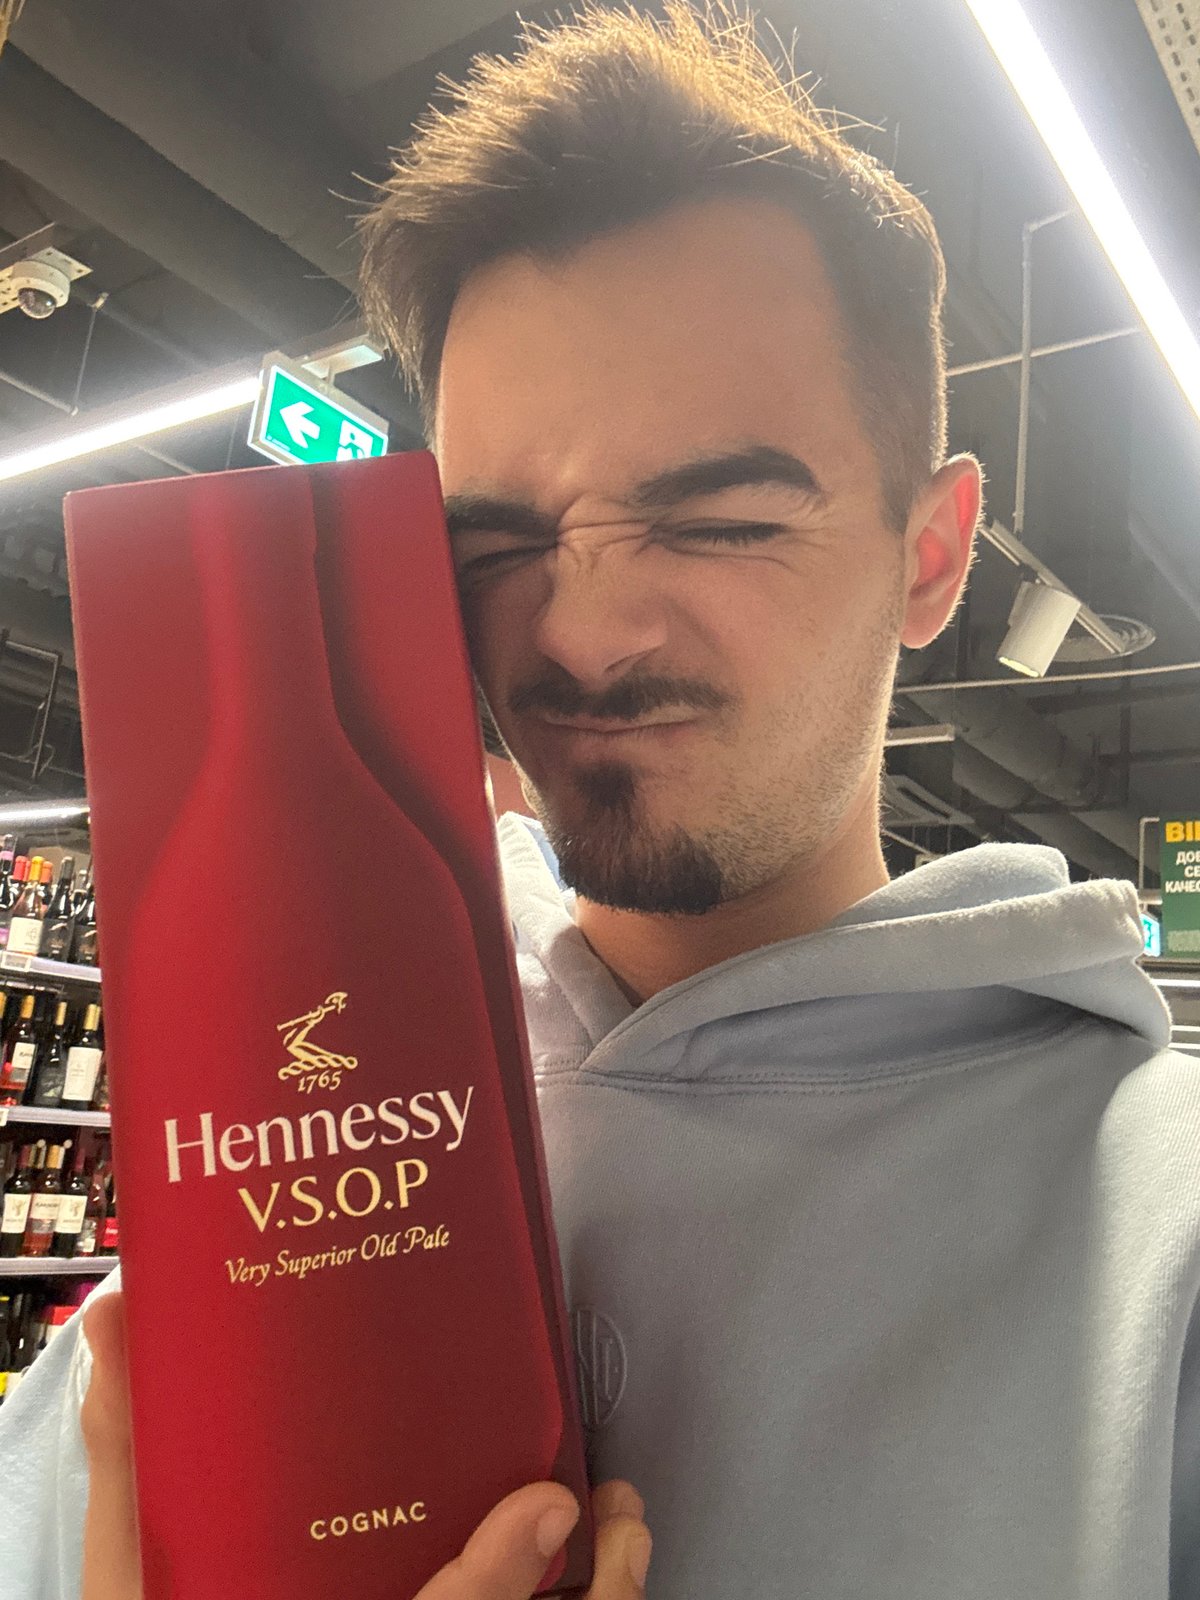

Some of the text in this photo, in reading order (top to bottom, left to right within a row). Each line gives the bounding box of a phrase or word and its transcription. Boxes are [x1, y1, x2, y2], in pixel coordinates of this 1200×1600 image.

[297, 1070, 343, 1094] 1765
[164, 1086, 474, 1183] Hennessy
[238, 1158, 429, 1233] V.S.O.P
[225, 1224, 450, 1287] Very Superior Old Pale
[310, 1501, 427, 1541] COGNAC
